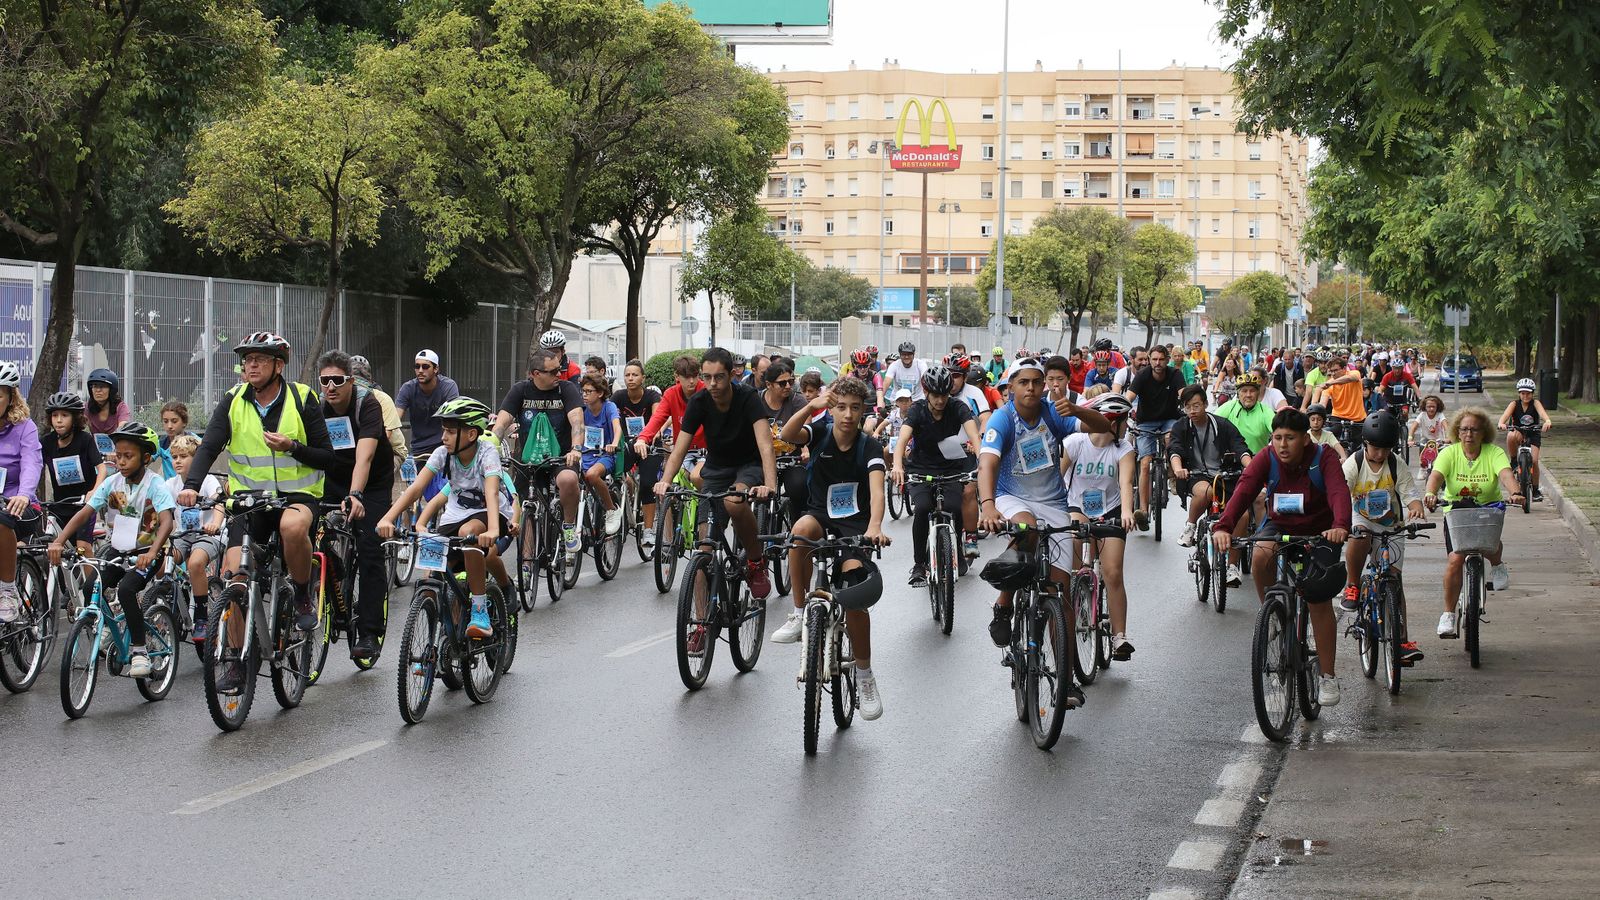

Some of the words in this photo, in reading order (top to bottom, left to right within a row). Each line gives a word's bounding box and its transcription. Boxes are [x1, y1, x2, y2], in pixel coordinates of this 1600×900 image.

[892, 152, 959, 161] McDonald's
[13, 304, 33, 320] AQU
[0, 331, 26, 348] UEDES
[1076, 462, 1114, 477] SOHO
